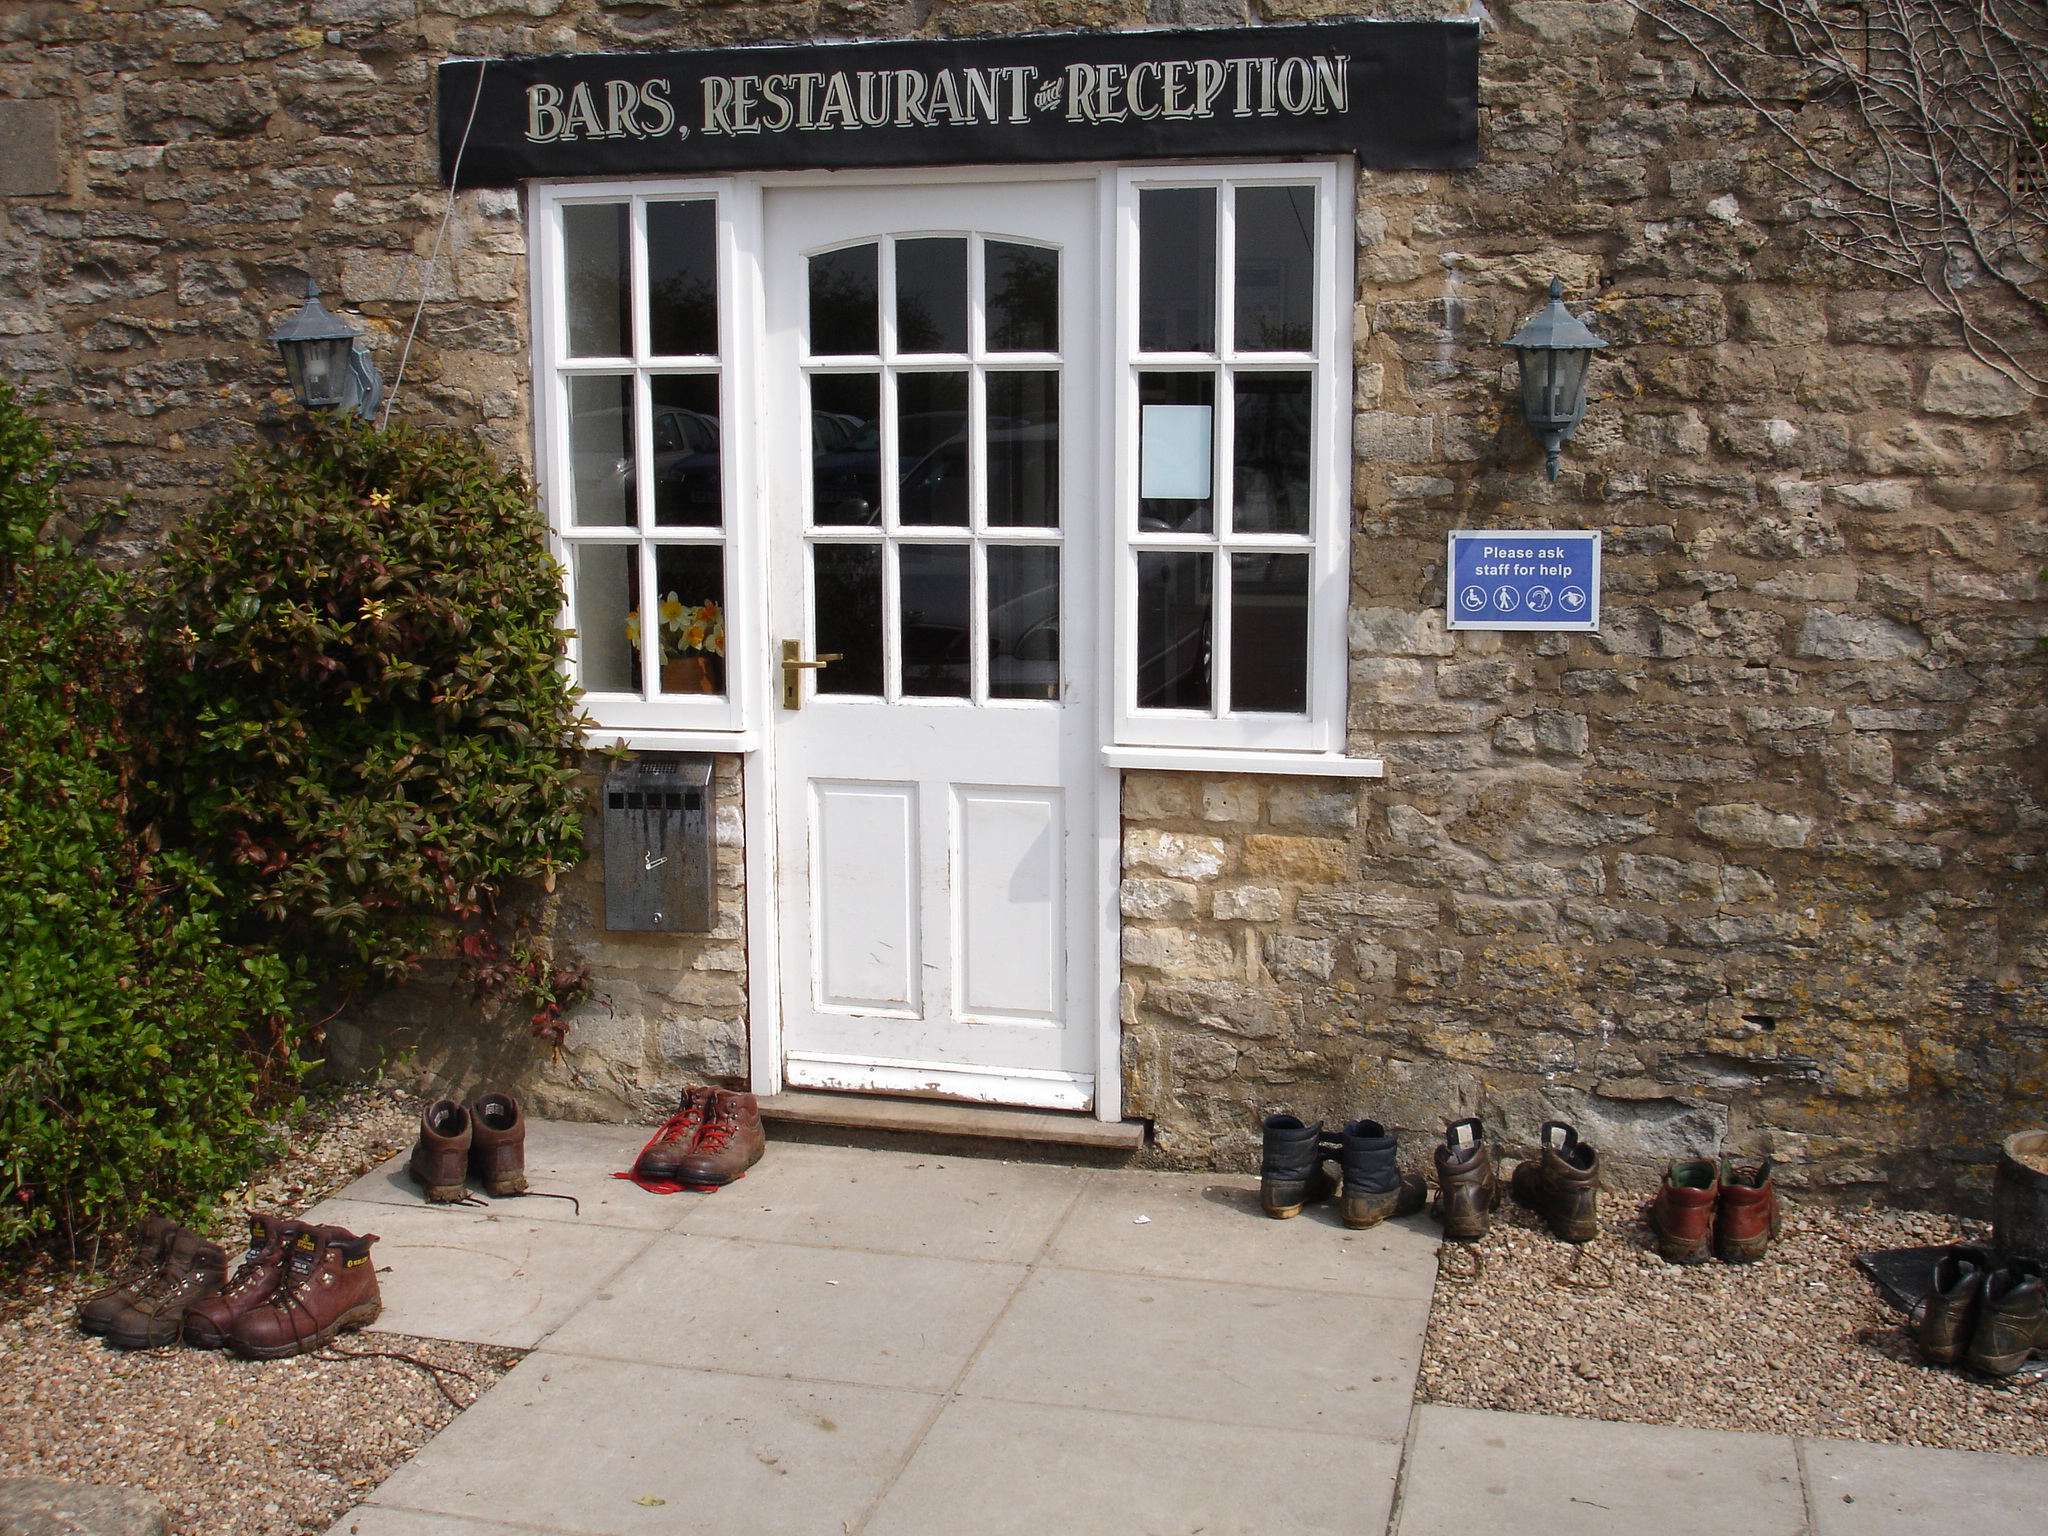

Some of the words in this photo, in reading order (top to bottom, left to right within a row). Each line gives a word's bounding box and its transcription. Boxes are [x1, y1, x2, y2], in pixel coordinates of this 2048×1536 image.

[525, 78, 690, 144] BARS,
[700, 64, 1039, 138] RESTAURANT
[1034, 77, 1064, 112] and
[1065, 54, 1351, 125] RECEPTION
[1483, 546, 1533, 559] Please
[1538, 546, 1565, 559] ask
[1475, 563, 1511, 576] staff
[1513, 563, 1535, 576] for
[1539, 563, 1573, 578] help
